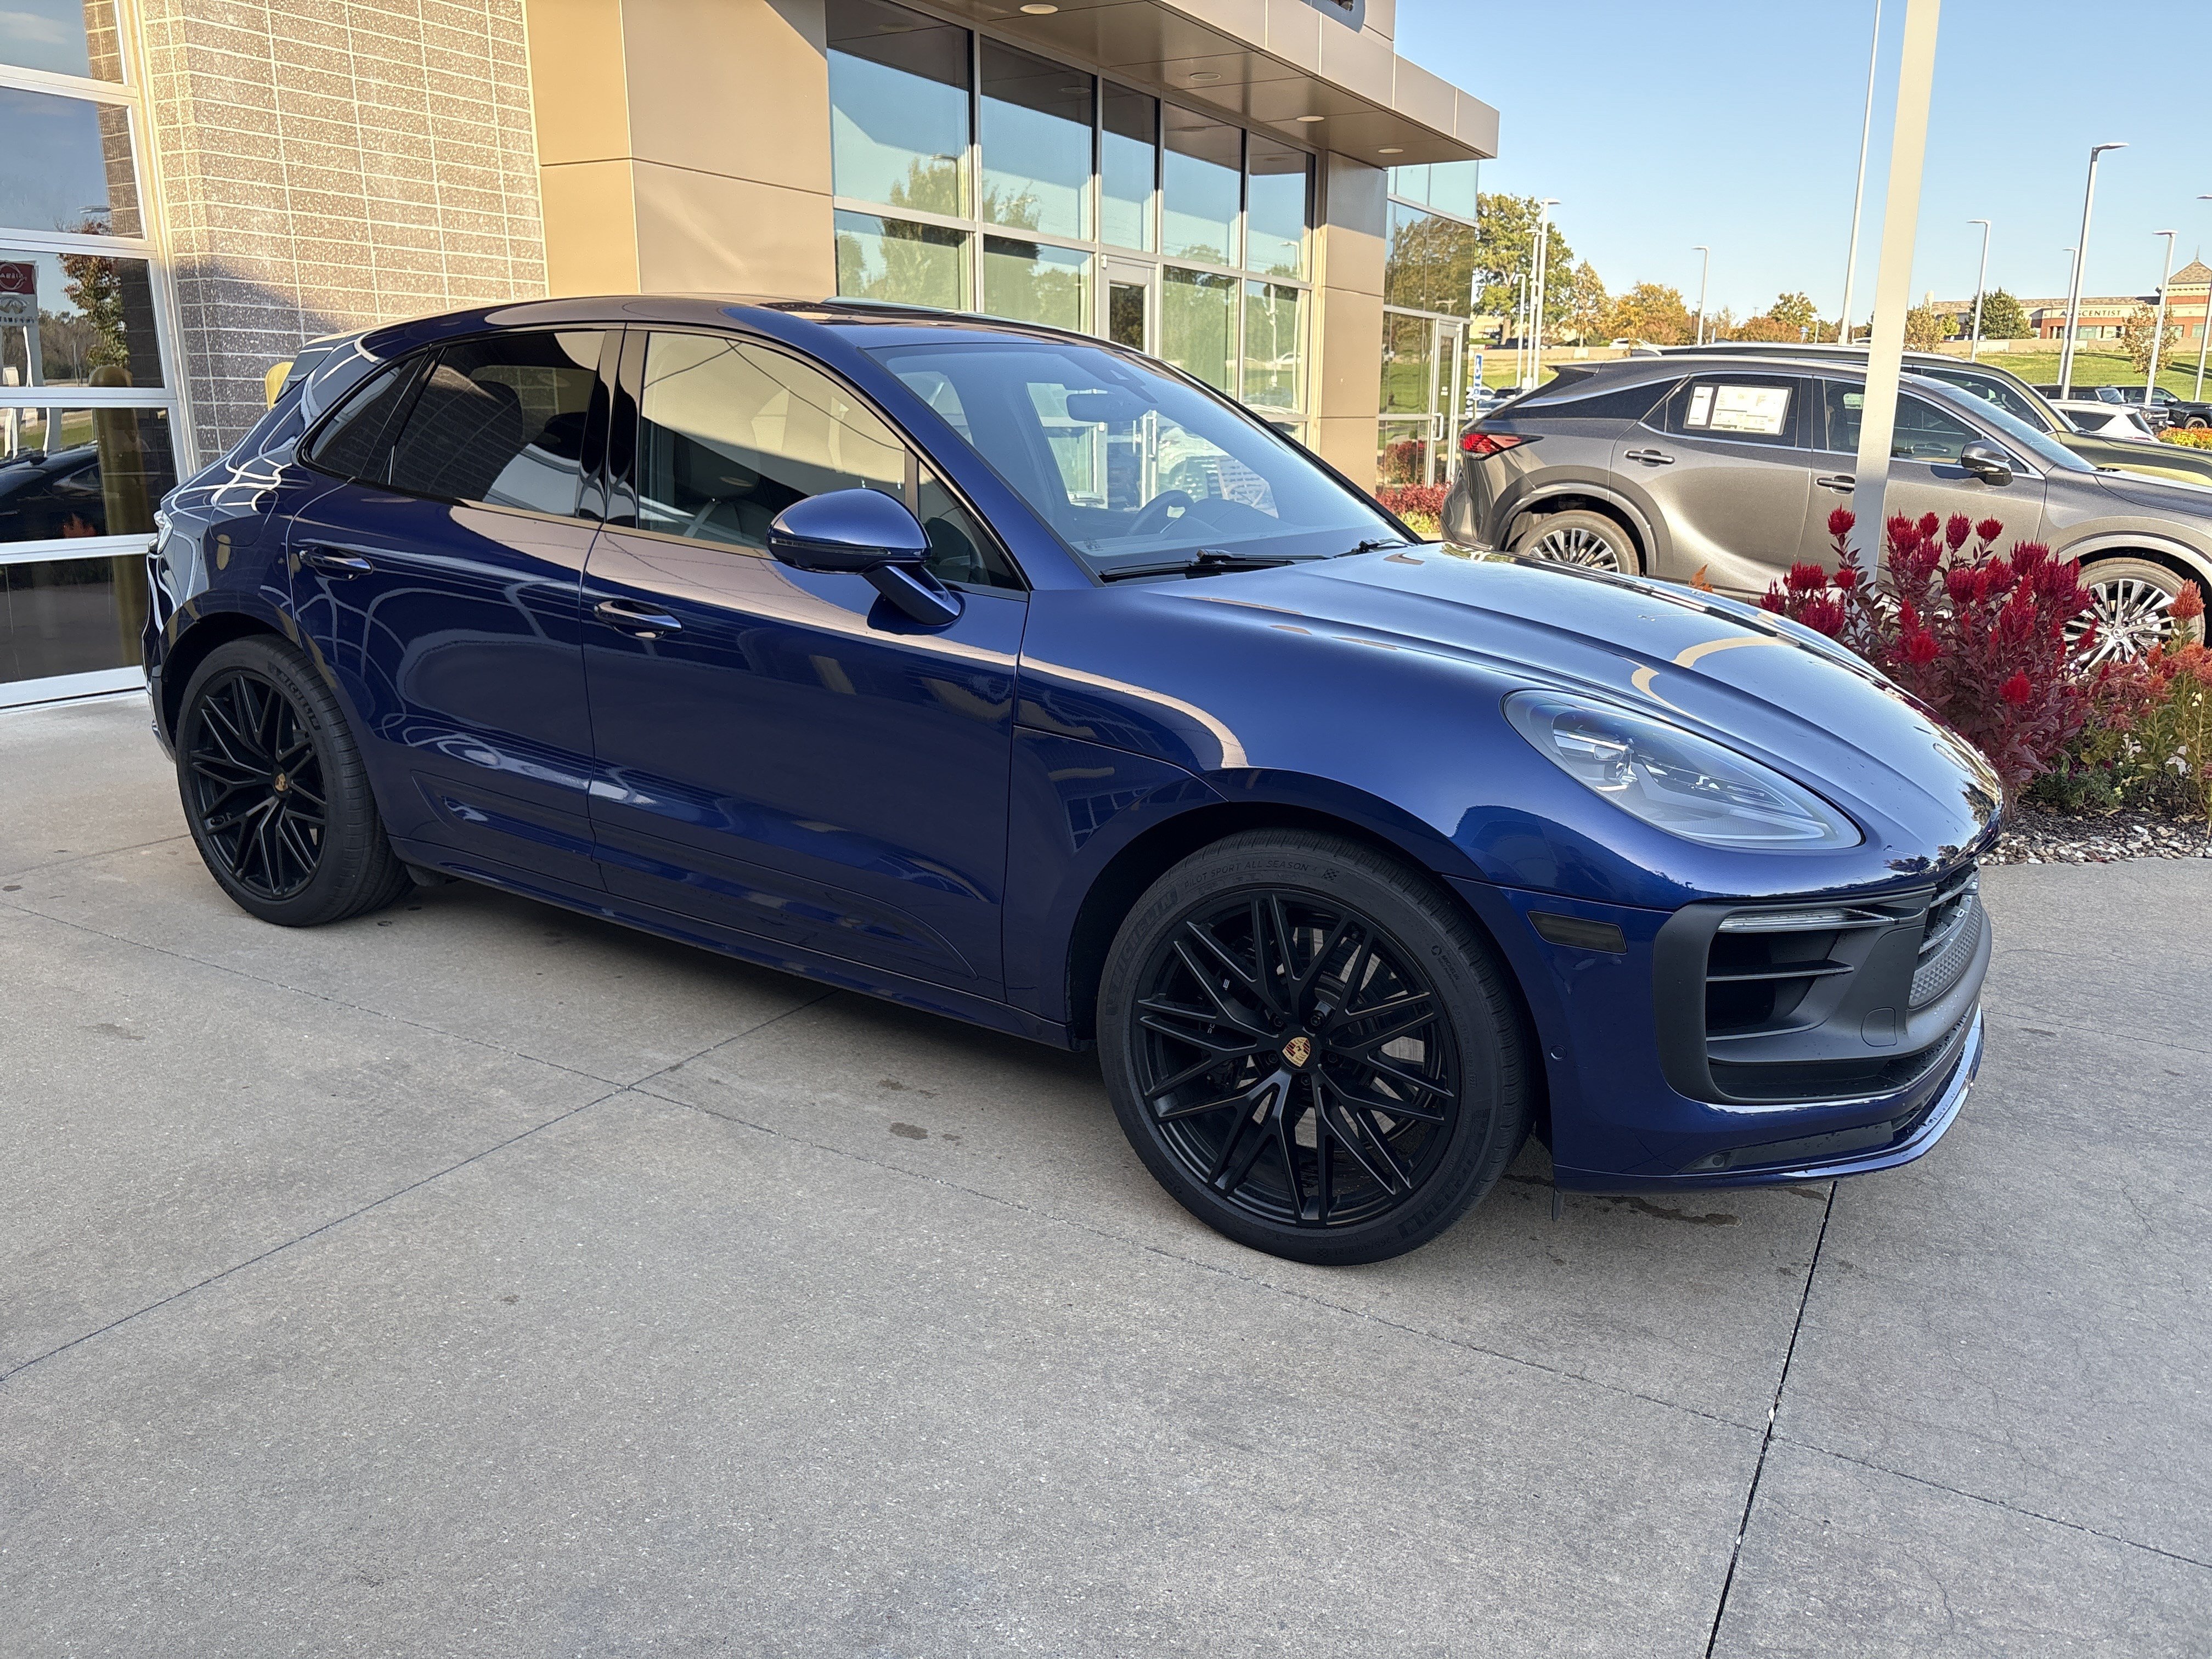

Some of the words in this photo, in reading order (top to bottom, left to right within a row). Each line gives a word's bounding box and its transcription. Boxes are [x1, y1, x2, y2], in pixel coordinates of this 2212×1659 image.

[279, 673, 319, 727] MICHELIN
[1184, 871, 1207, 889] PILOT
[1211, 862, 1239, 877] SPORT
[1244, 860, 1262, 869] ALL
[1266, 860, 1310, 872] SEASON
[1112, 892, 1175, 988] MICHELIN
[1404, 1142, 1480, 1234] MICHELIN
